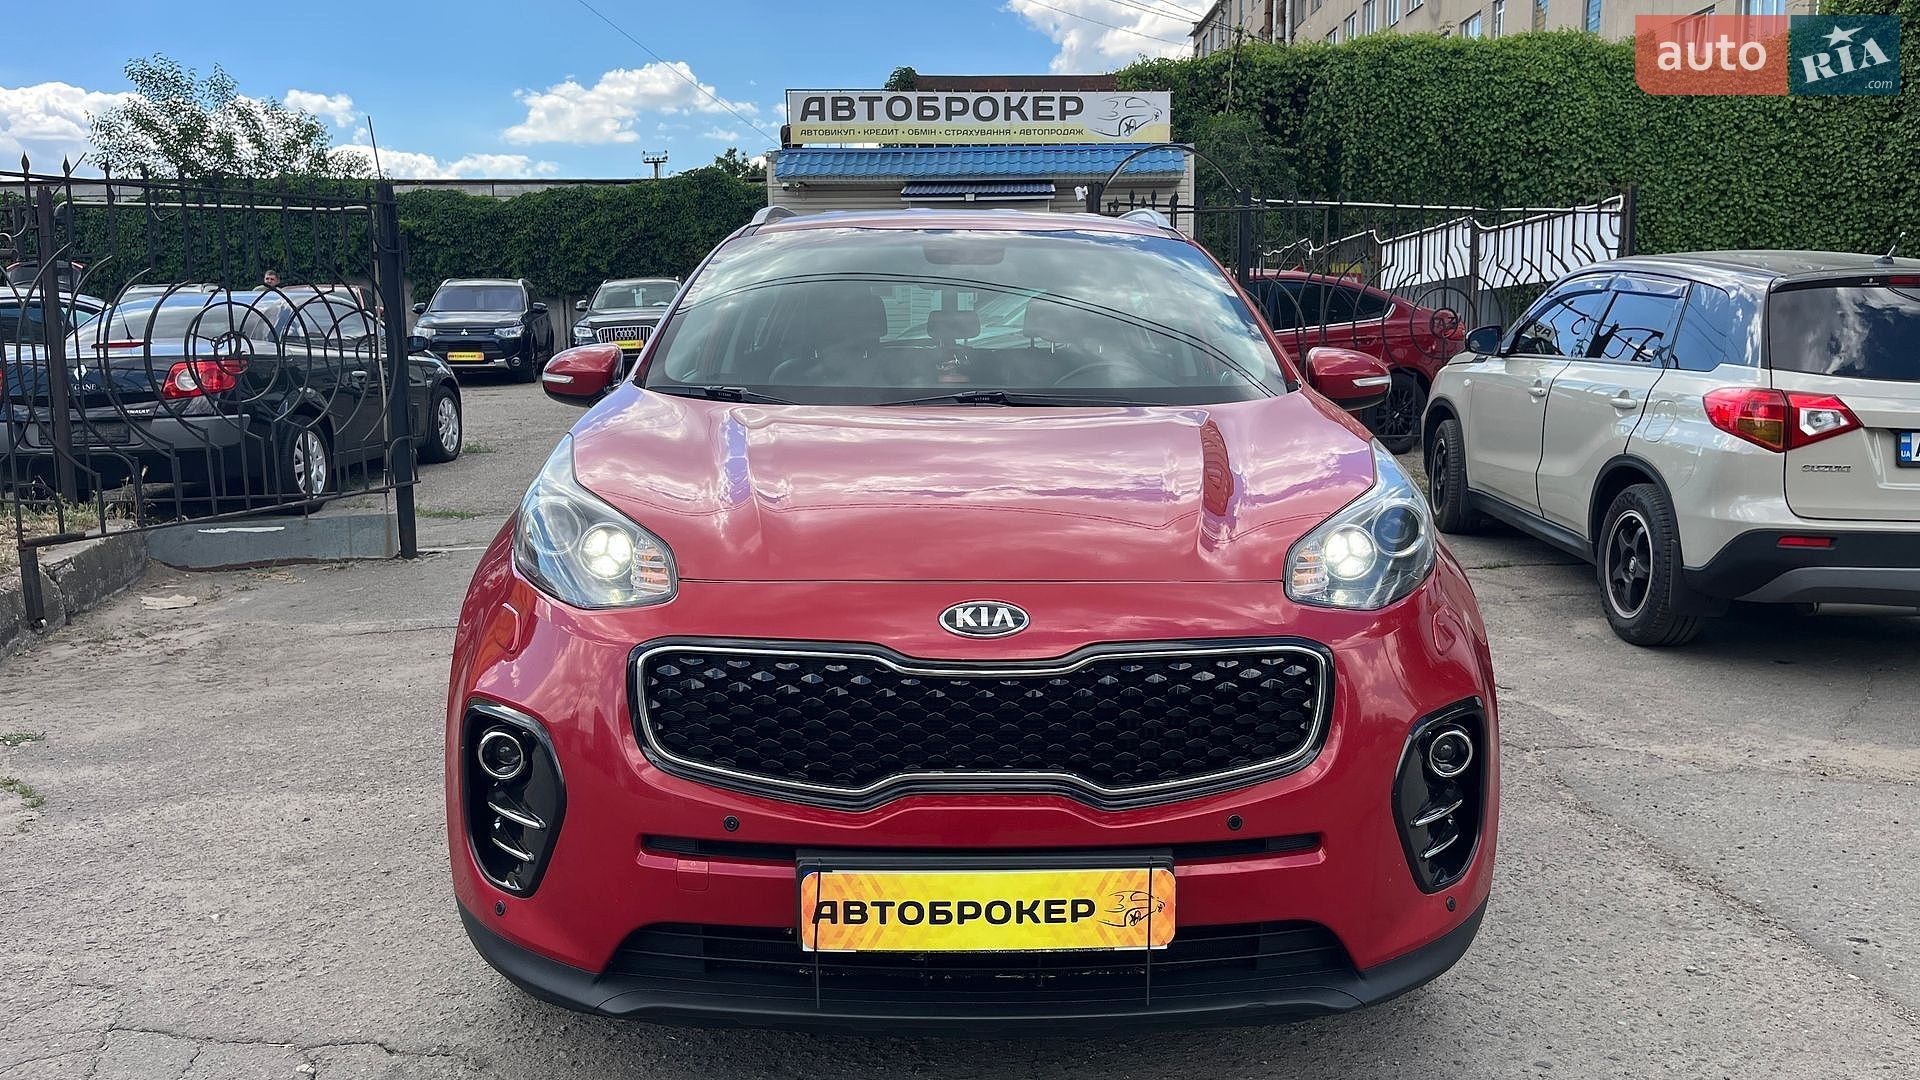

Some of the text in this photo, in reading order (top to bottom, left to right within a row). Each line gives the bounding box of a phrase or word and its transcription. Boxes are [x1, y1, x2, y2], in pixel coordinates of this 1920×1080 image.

[800, 95, 1084, 121] АВТОБРОКЕР
[800, 128, 855, 136] АВТОВИКУП
[863, 128, 900, 136] КРЕДИТ
[944, 128, 1011, 136] СТРАХУВАННЯ
[1019, 128, 1084, 136] АВТОПРОДАЖ
[1900, 449, 1911, 458] UA
[954, 606, 1015, 628] KIA
[812, 898, 1096, 926] АВТОБРОКЕР
